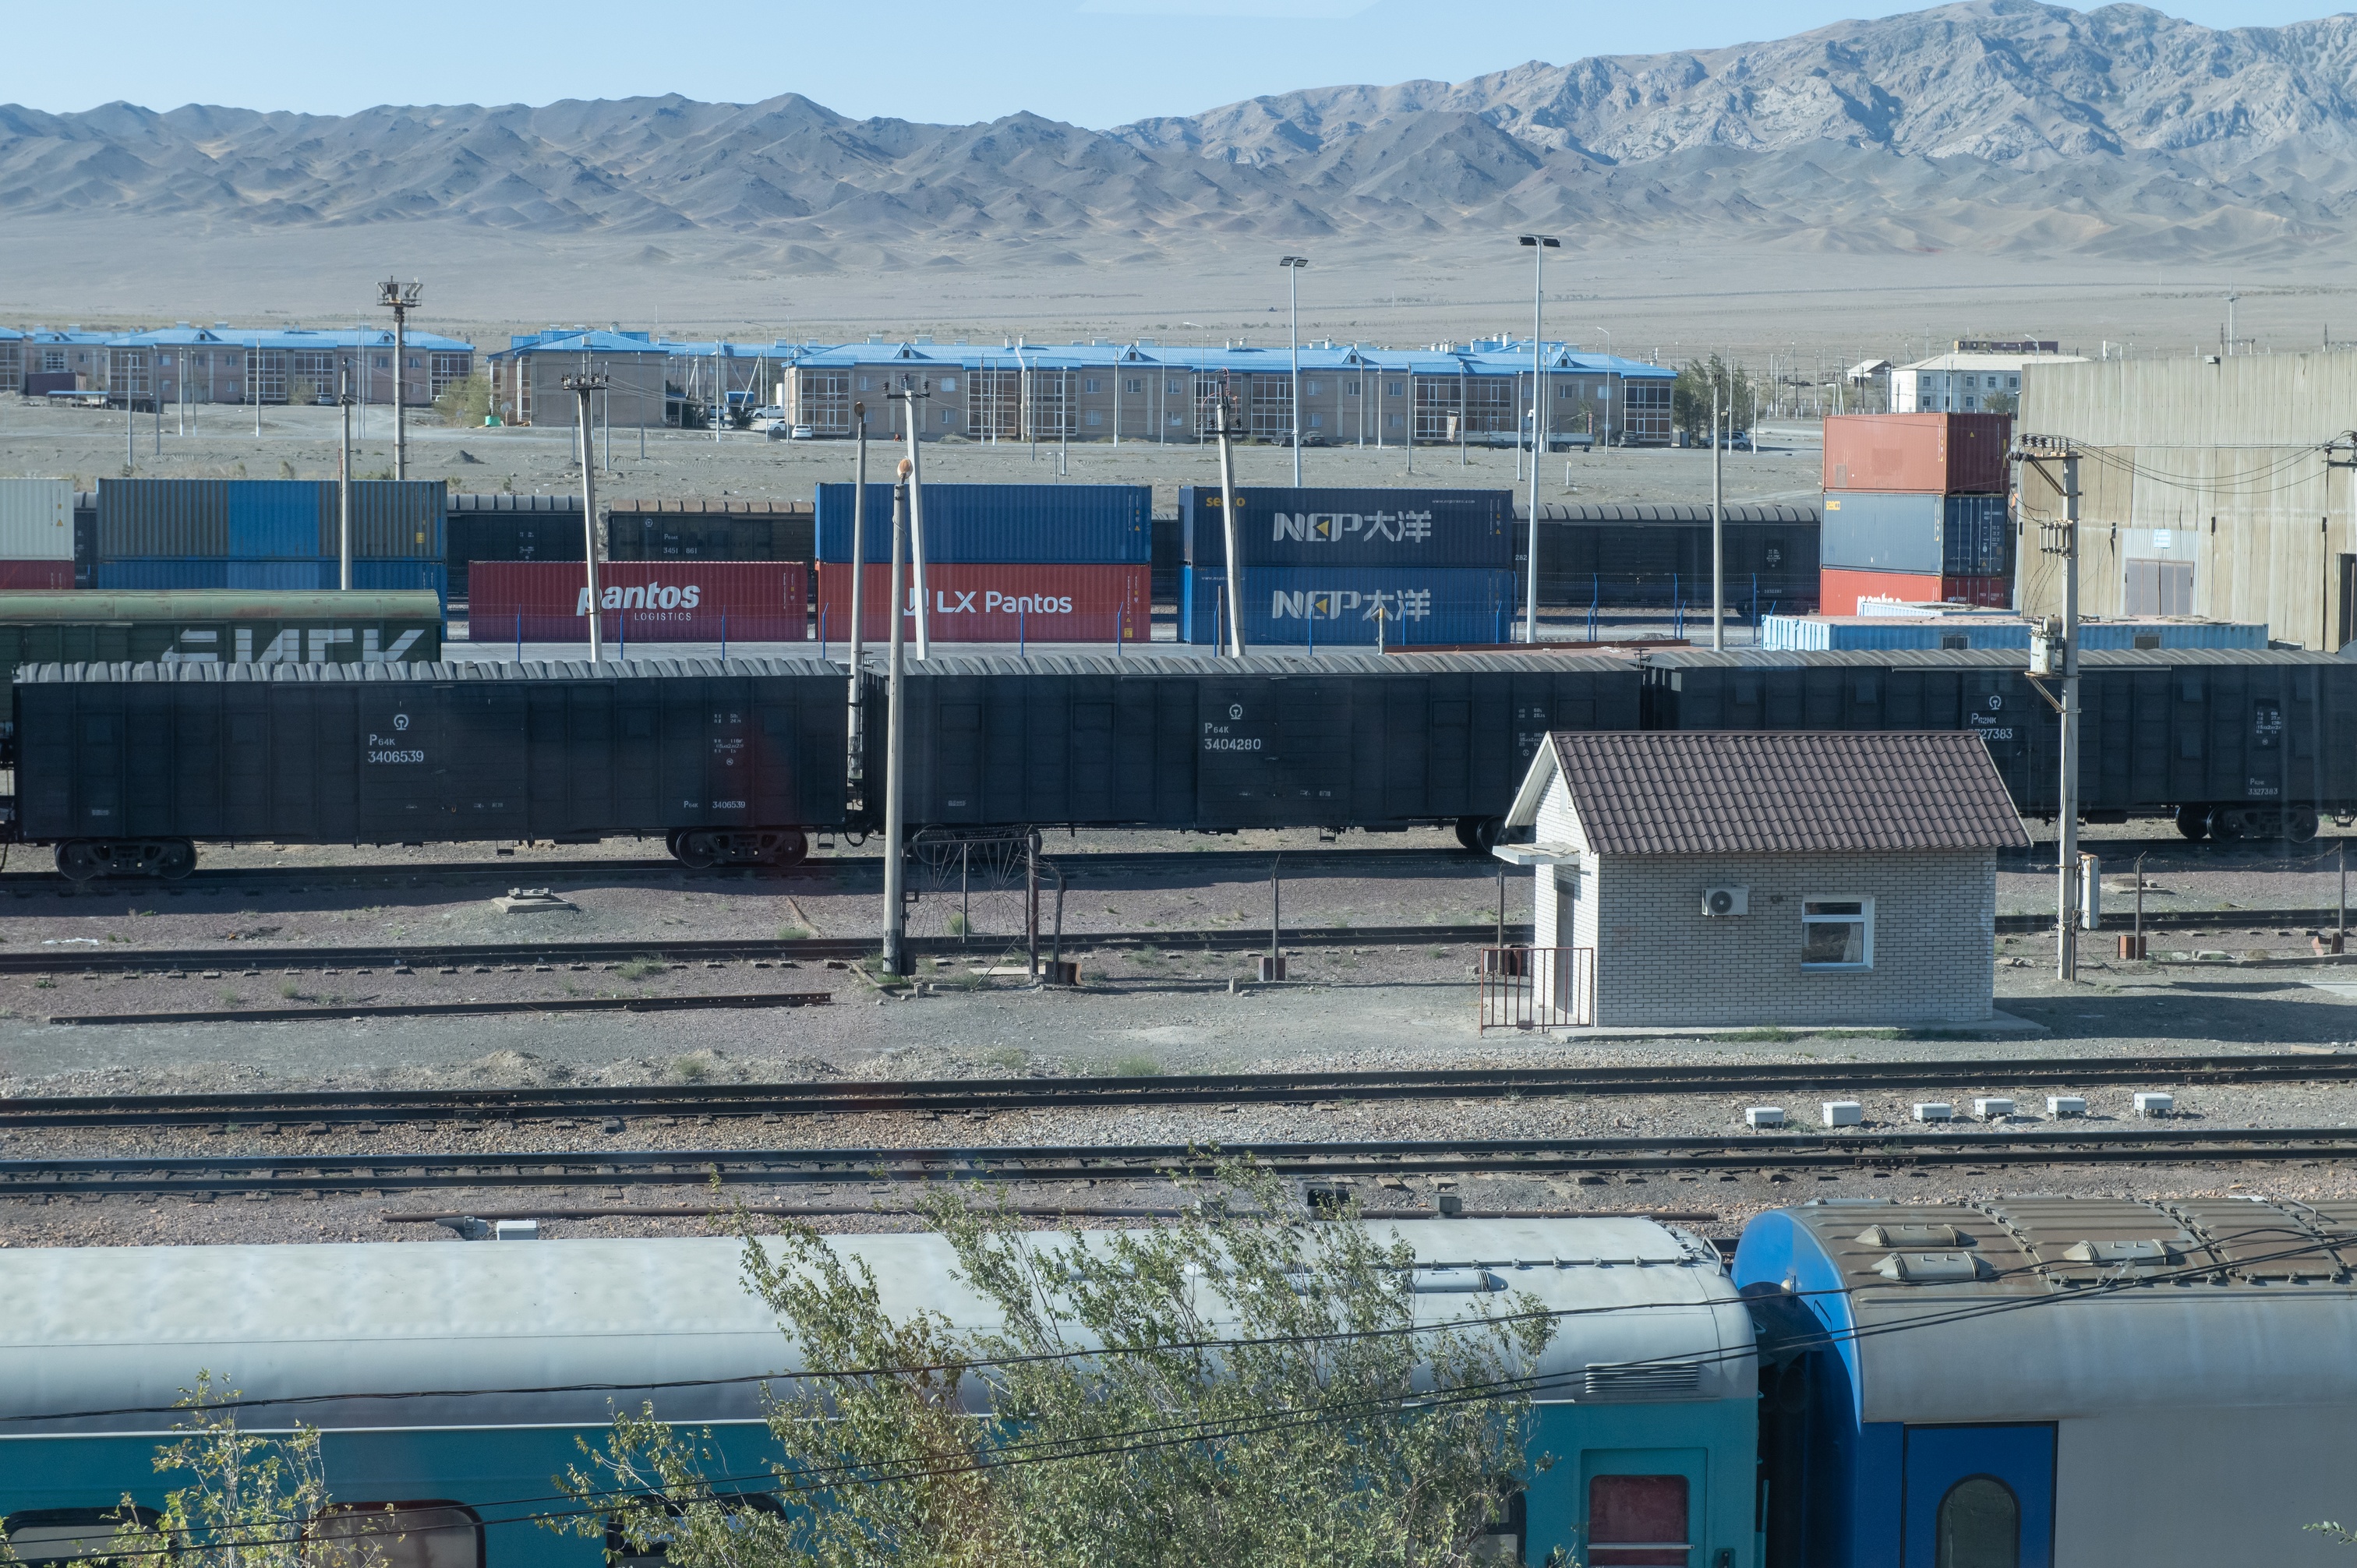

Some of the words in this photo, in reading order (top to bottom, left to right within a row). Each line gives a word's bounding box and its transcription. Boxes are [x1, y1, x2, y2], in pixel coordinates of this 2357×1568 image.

[1206, 496, 1246, 507] seo
[937, 591, 977, 613] LX
[985, 591, 1073, 613] Pantos
[634, 613, 691, 621] LOGISTICS
[1971, 712, 1997, 725] P62NK
[1204, 722, 1229, 734] P64K
[1967, 728, 2013, 740] 27383
[369, 733, 396, 746] P64K
[1204, 738, 1261, 750] 3404280
[368, 750, 424, 763] 3406539
[712, 800, 746, 809] 3406539
